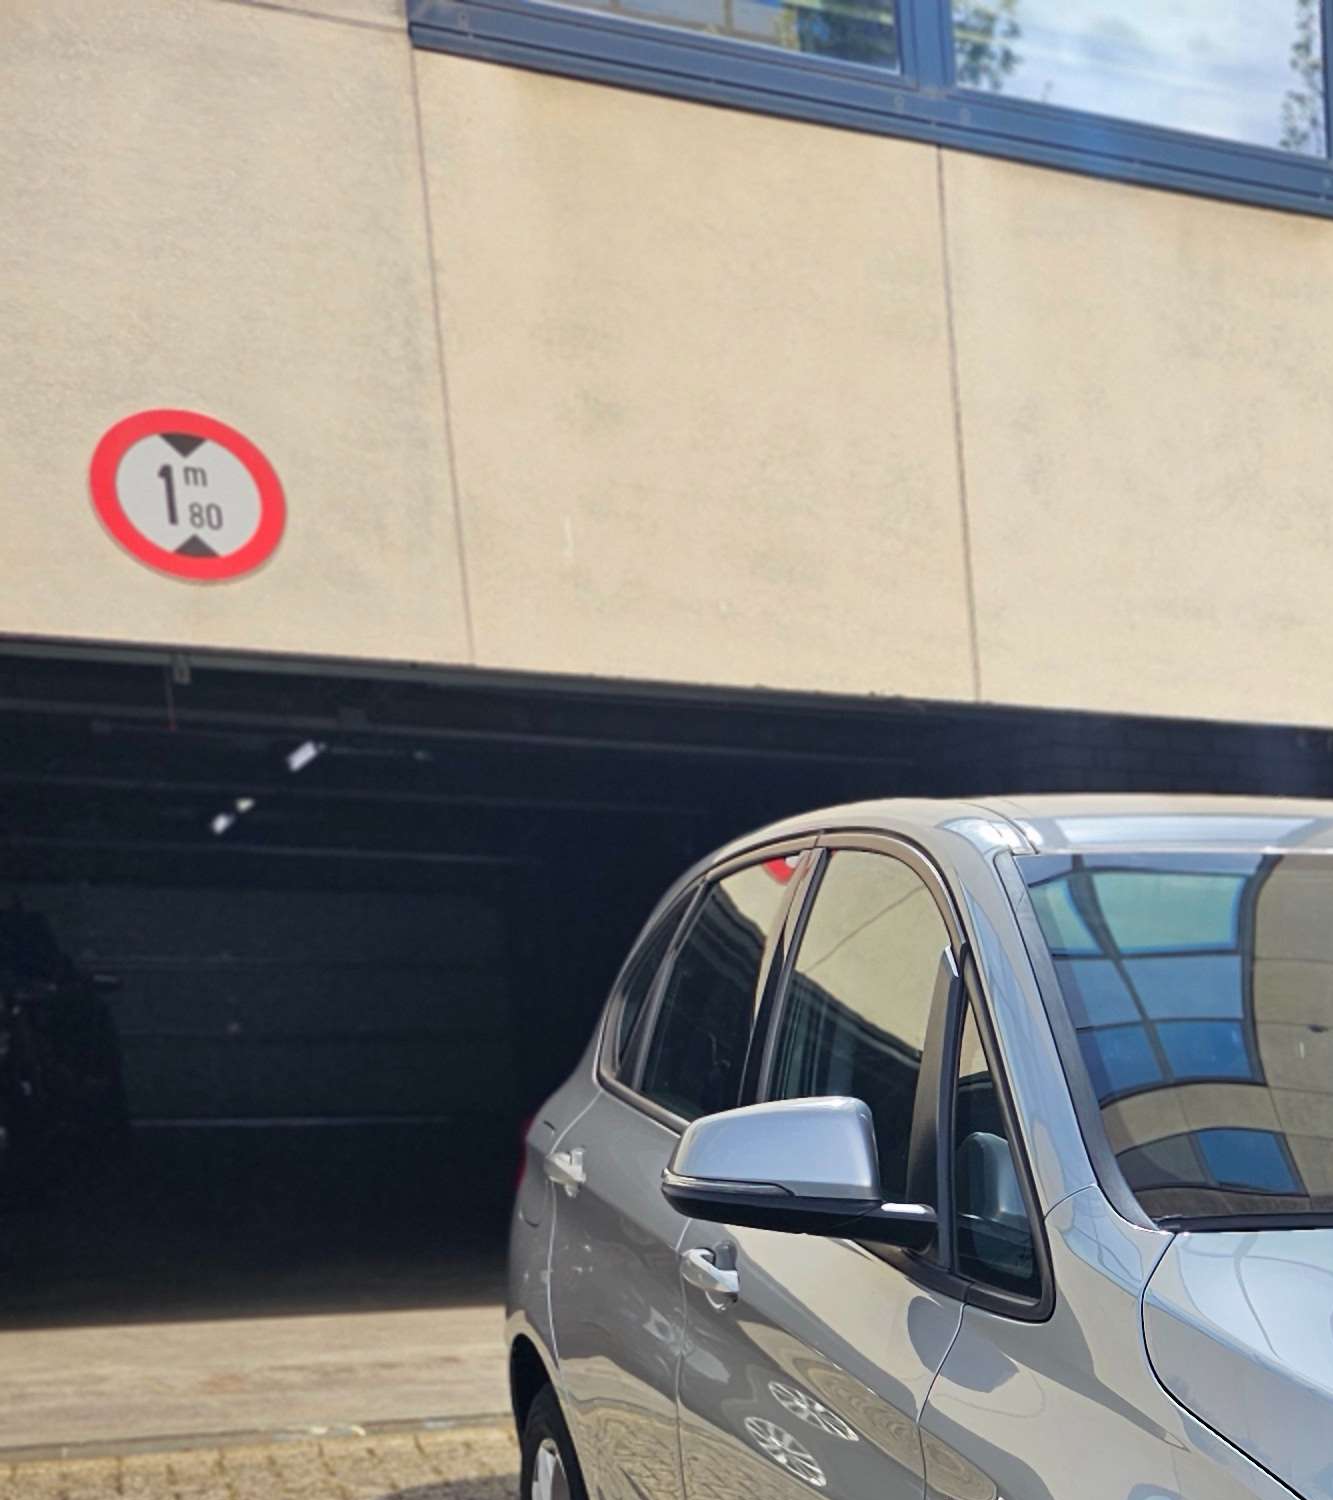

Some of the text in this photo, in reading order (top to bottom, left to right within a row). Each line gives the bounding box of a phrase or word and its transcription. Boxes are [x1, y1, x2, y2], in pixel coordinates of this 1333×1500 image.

[157, 463, 207, 526] 1 m
[189, 502, 223, 531] 80
